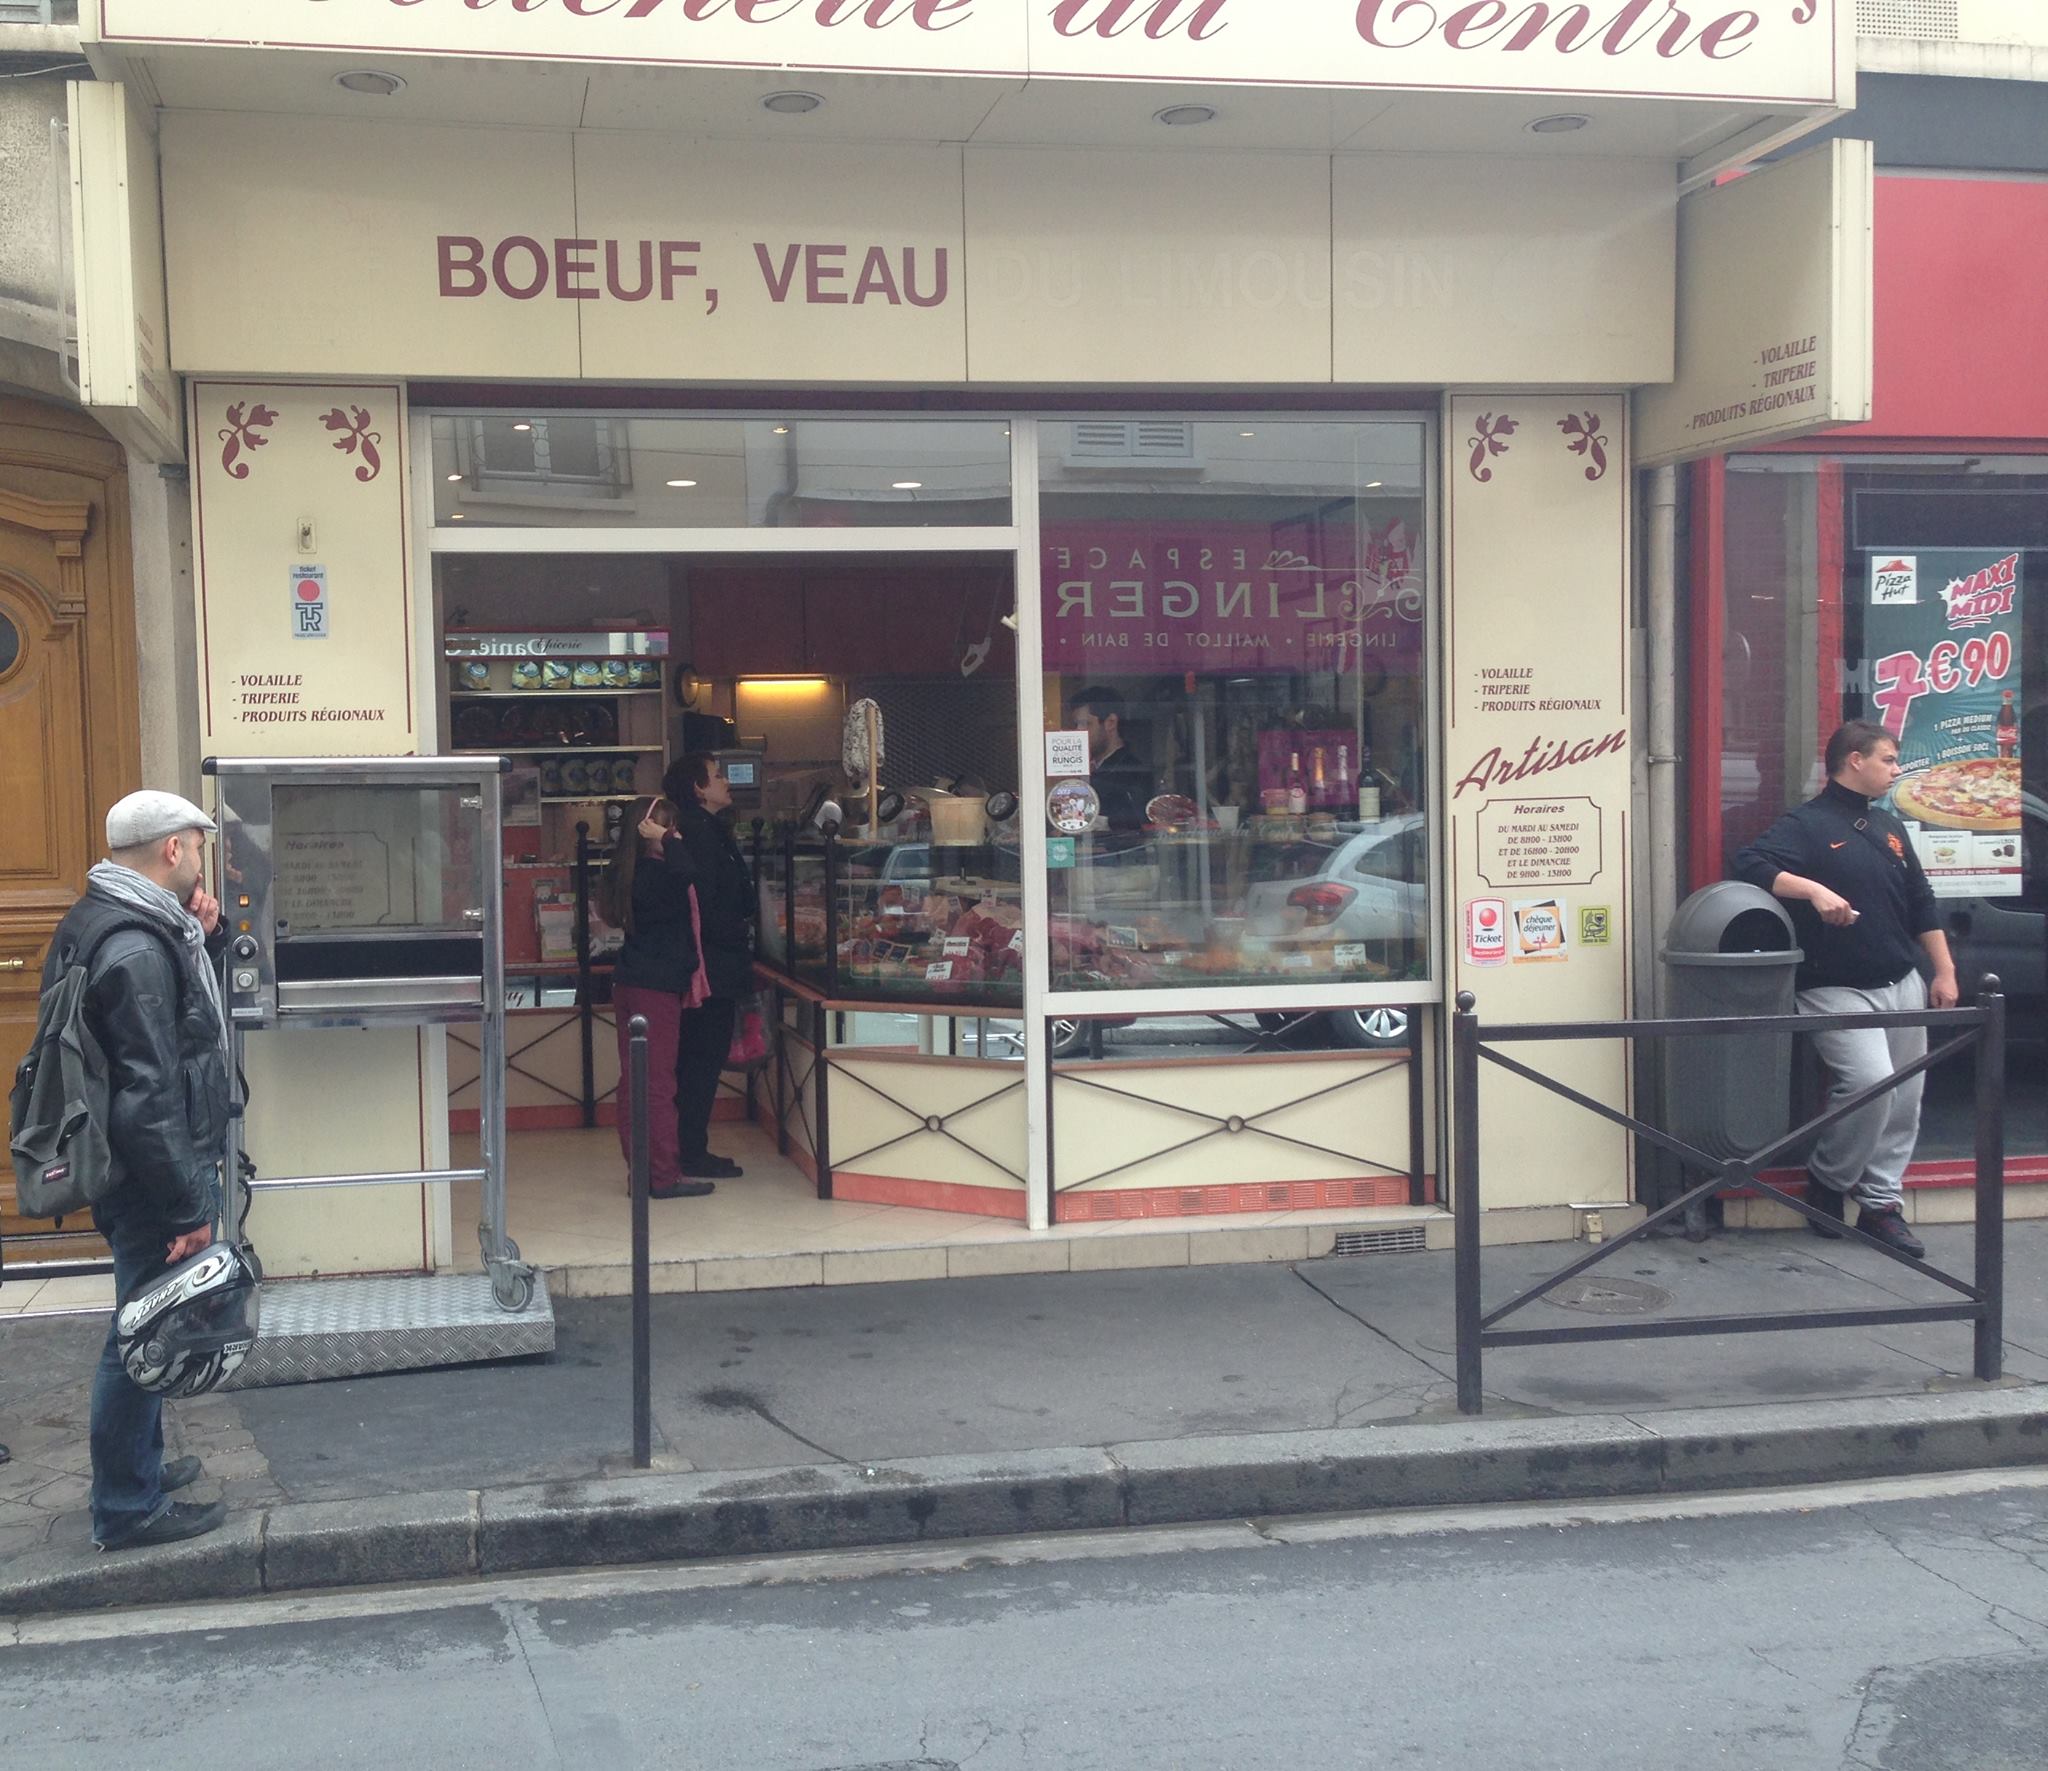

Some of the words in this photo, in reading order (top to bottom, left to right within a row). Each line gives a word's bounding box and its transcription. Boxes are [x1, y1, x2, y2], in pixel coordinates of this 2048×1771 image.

[435, 235, 719, 316] BOEUF,
[752, 242, 949, 307] VEAU
[1760, 335, 1817, 365] VOLAILLE
[1763, 360, 1817, 388] TRIPERIE
[1692, 402, 1747, 430] PRODUITS
[1749, 384, 1817, 415] RÉGIONAUX
[1875, 572, 1913, 591] Pizza
[1949, 553, 2019, 601] MAXI
[1881, 585, 1910, 600] Hut
[1948, 585, 2017, 621] MIDI
[1481, 667, 1534, 679] VOLAILLE
[240, 674, 303, 687] VOLAILLE
[1481, 684, 1531, 696] TRIPERIE
[240, 692, 301, 705] TRIPERIE
[1481, 700, 1536, 712] PRODUITS
[1538, 697, 1602, 711] RÉGIONAUX
[241, 709, 307, 723] PRODUITS
[310, 706, 386, 722] RÉGIONAUX
[1052, 756, 1083, 764] RUNGIS
[1452, 729, 1627, 800] Artisan
[1513, 804, 1566, 815] Horaires
[1497, 825, 1509, 833] DU
[1511, 824, 1536, 833] MARDI
[1536, 824, 1548, 832] AU
[1549, 823, 1580, 832] SAMEDI
[1507, 836, 1519, 844] DE
[1498, 848, 1509, 856] ET
[1509, 848, 1521, 856] DE
[1507, 859, 1517, 867] ET
[1518, 859, 1530, 867] LE
[1530, 857, 1571, 867] DIMANCHE
[1507, 871, 1518, 879] DE
[1525, 915, 1553, 926] chèque
[1523, 923, 1556, 933] déjeuner
[1474, 934, 1503, 944] Ticket
